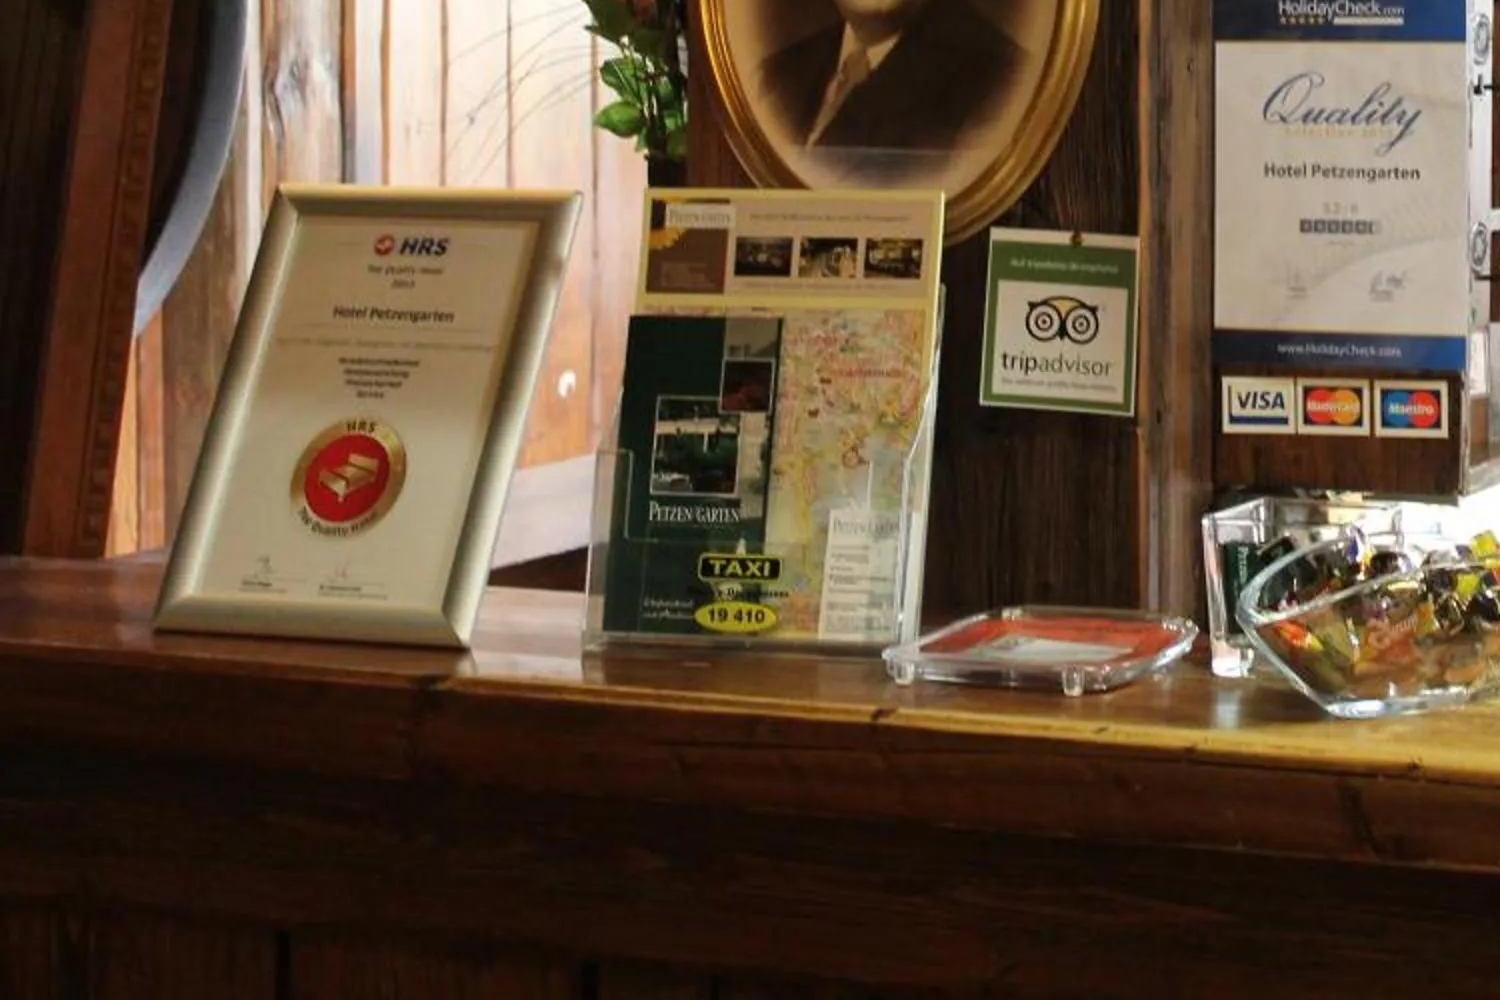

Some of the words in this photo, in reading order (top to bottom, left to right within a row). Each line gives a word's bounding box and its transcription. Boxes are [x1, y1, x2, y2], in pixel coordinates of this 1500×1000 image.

[1262, 71, 1422, 156] Quality
[1264, 163, 1307, 177] Hotel
[1310, 164, 1421, 181] Petzengarten
[399, 236, 450, 256] HRS
[332, 305, 368, 319] Hotel
[369, 306, 455, 324] Petzengarten
[1001, 350, 1113, 377] tripadvisor
[1237, 390, 1285, 410] VISA
[346, 419, 377, 433] HRS
[709, 559, 771, 577] TAXI
[708, 608, 728, 623] 19
[733, 609, 765, 624] 410
